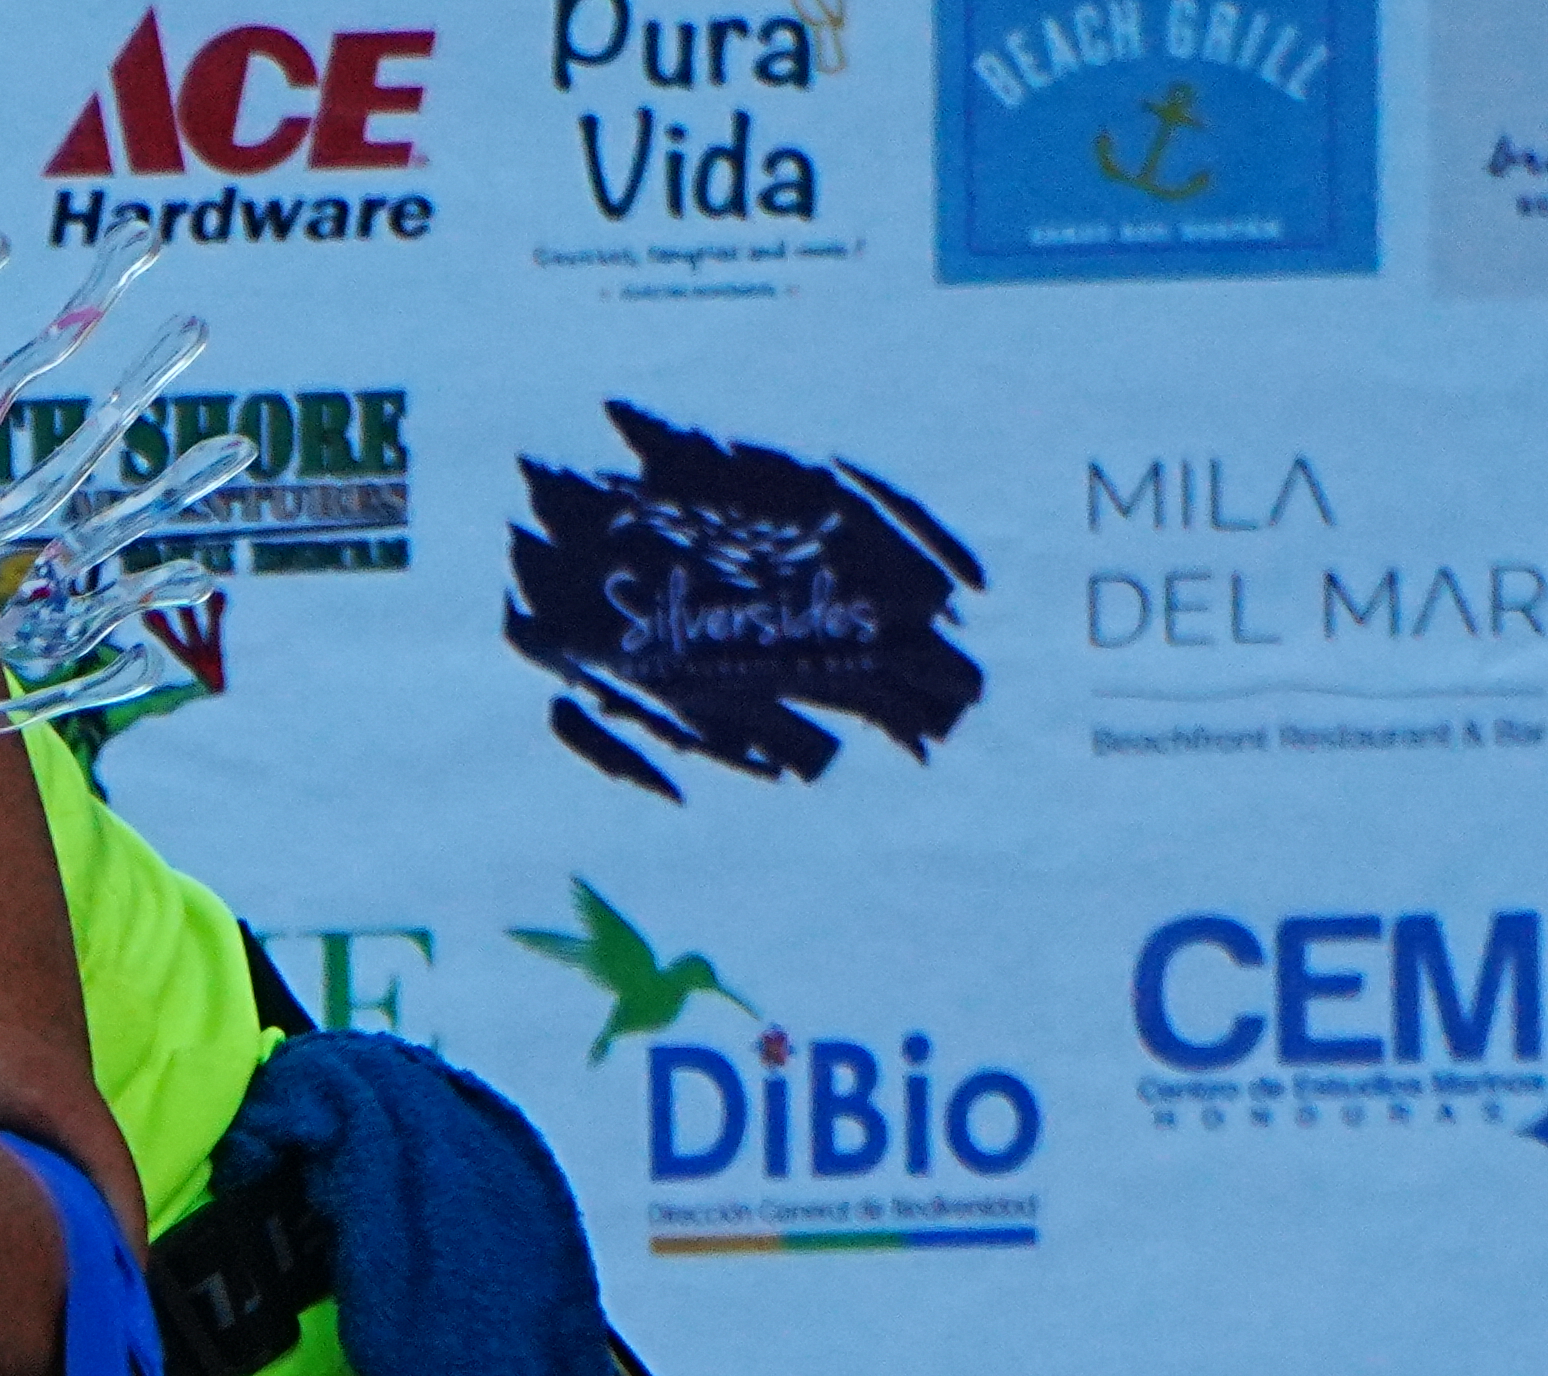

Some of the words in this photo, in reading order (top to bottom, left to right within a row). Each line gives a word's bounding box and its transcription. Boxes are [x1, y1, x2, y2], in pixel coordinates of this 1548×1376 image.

[41, 4, 438, 178] ACE
[47, 186, 436, 248] Hardware
[577, 105, 819, 222] Vida
[1085, 455, 1336, 534] MILA
[1085, 569, 1284, 649] DEL
[1322, 563, 1548, 643] MAR
[1132, 910, 1543, 1074] CEM
[645, 1024, 1044, 1185] DiBio
